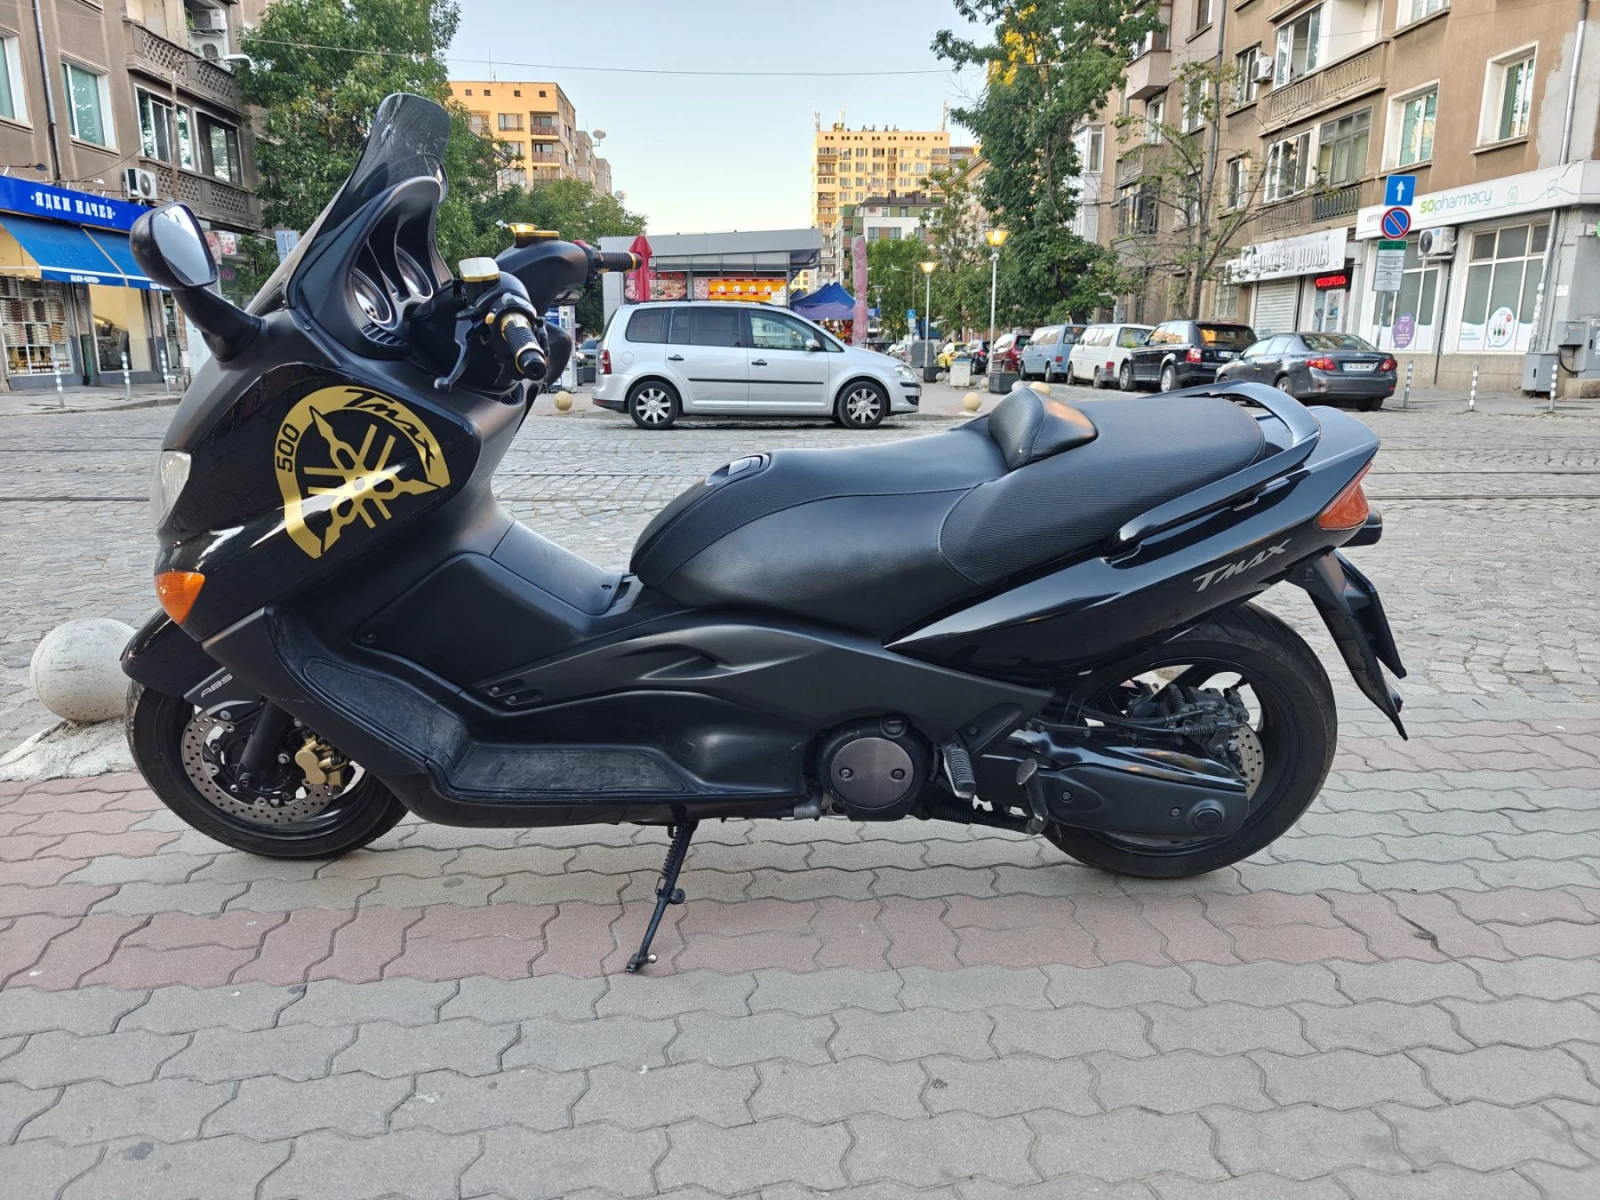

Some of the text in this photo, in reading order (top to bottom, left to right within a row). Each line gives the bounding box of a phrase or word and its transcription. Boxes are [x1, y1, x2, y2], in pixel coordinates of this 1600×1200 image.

[75, 200, 113, 219] НАЧЕВ
[1420, 190, 1492, 214] sopharmacy
[276, 423, 300, 472] 500
[1192, 538, 1292, 592] TMAX
[201, 673, 233, 698] ABS
